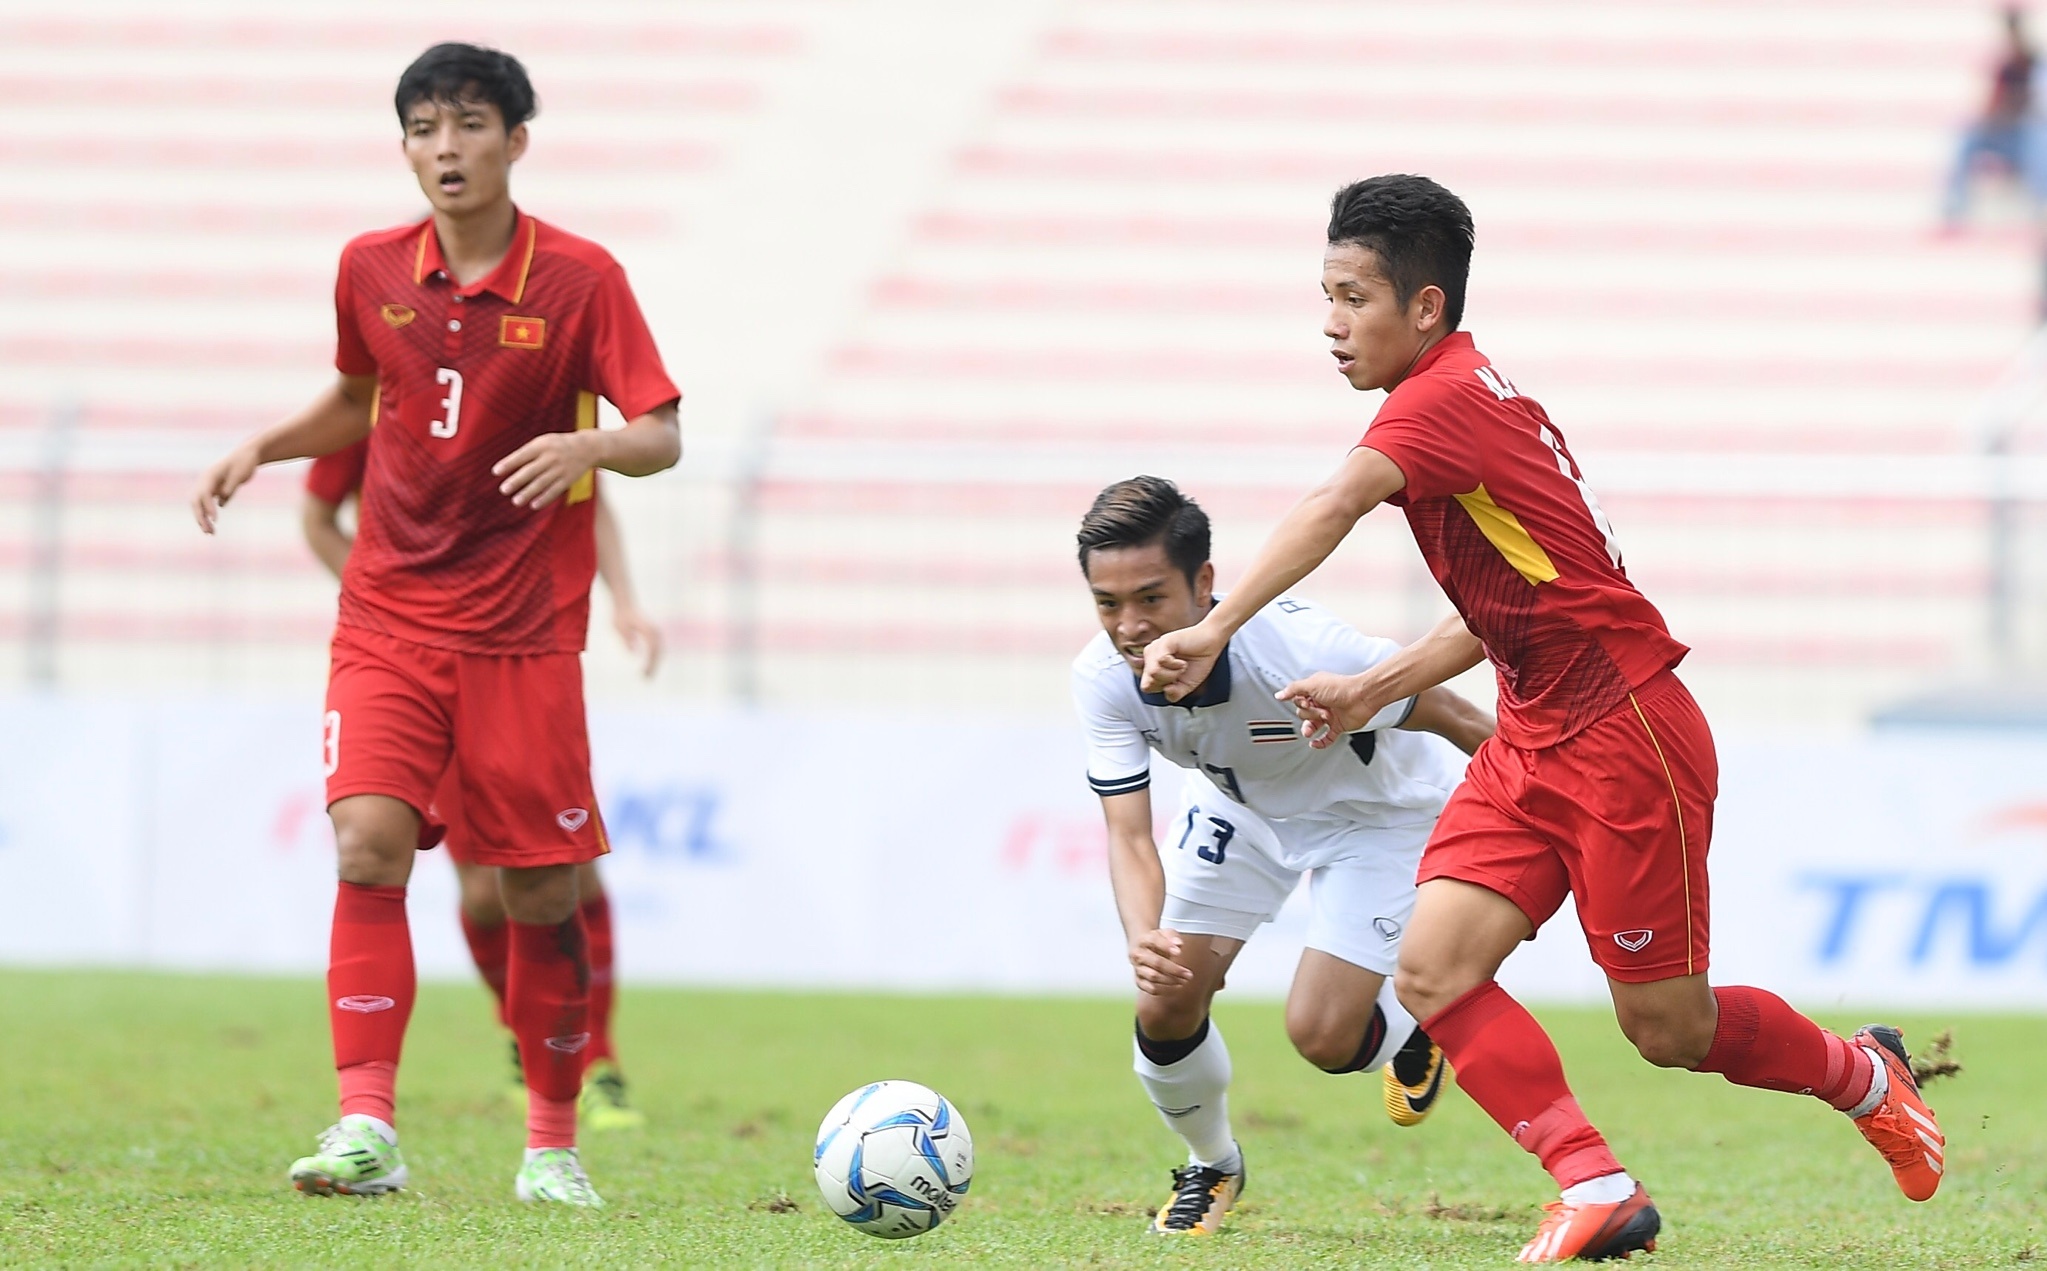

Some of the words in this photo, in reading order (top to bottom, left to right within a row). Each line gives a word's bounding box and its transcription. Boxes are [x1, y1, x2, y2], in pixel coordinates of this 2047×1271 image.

[430, 366, 463, 439] 3
[323, 709, 342, 779] 3
[1178, 804, 1235, 865] 13
